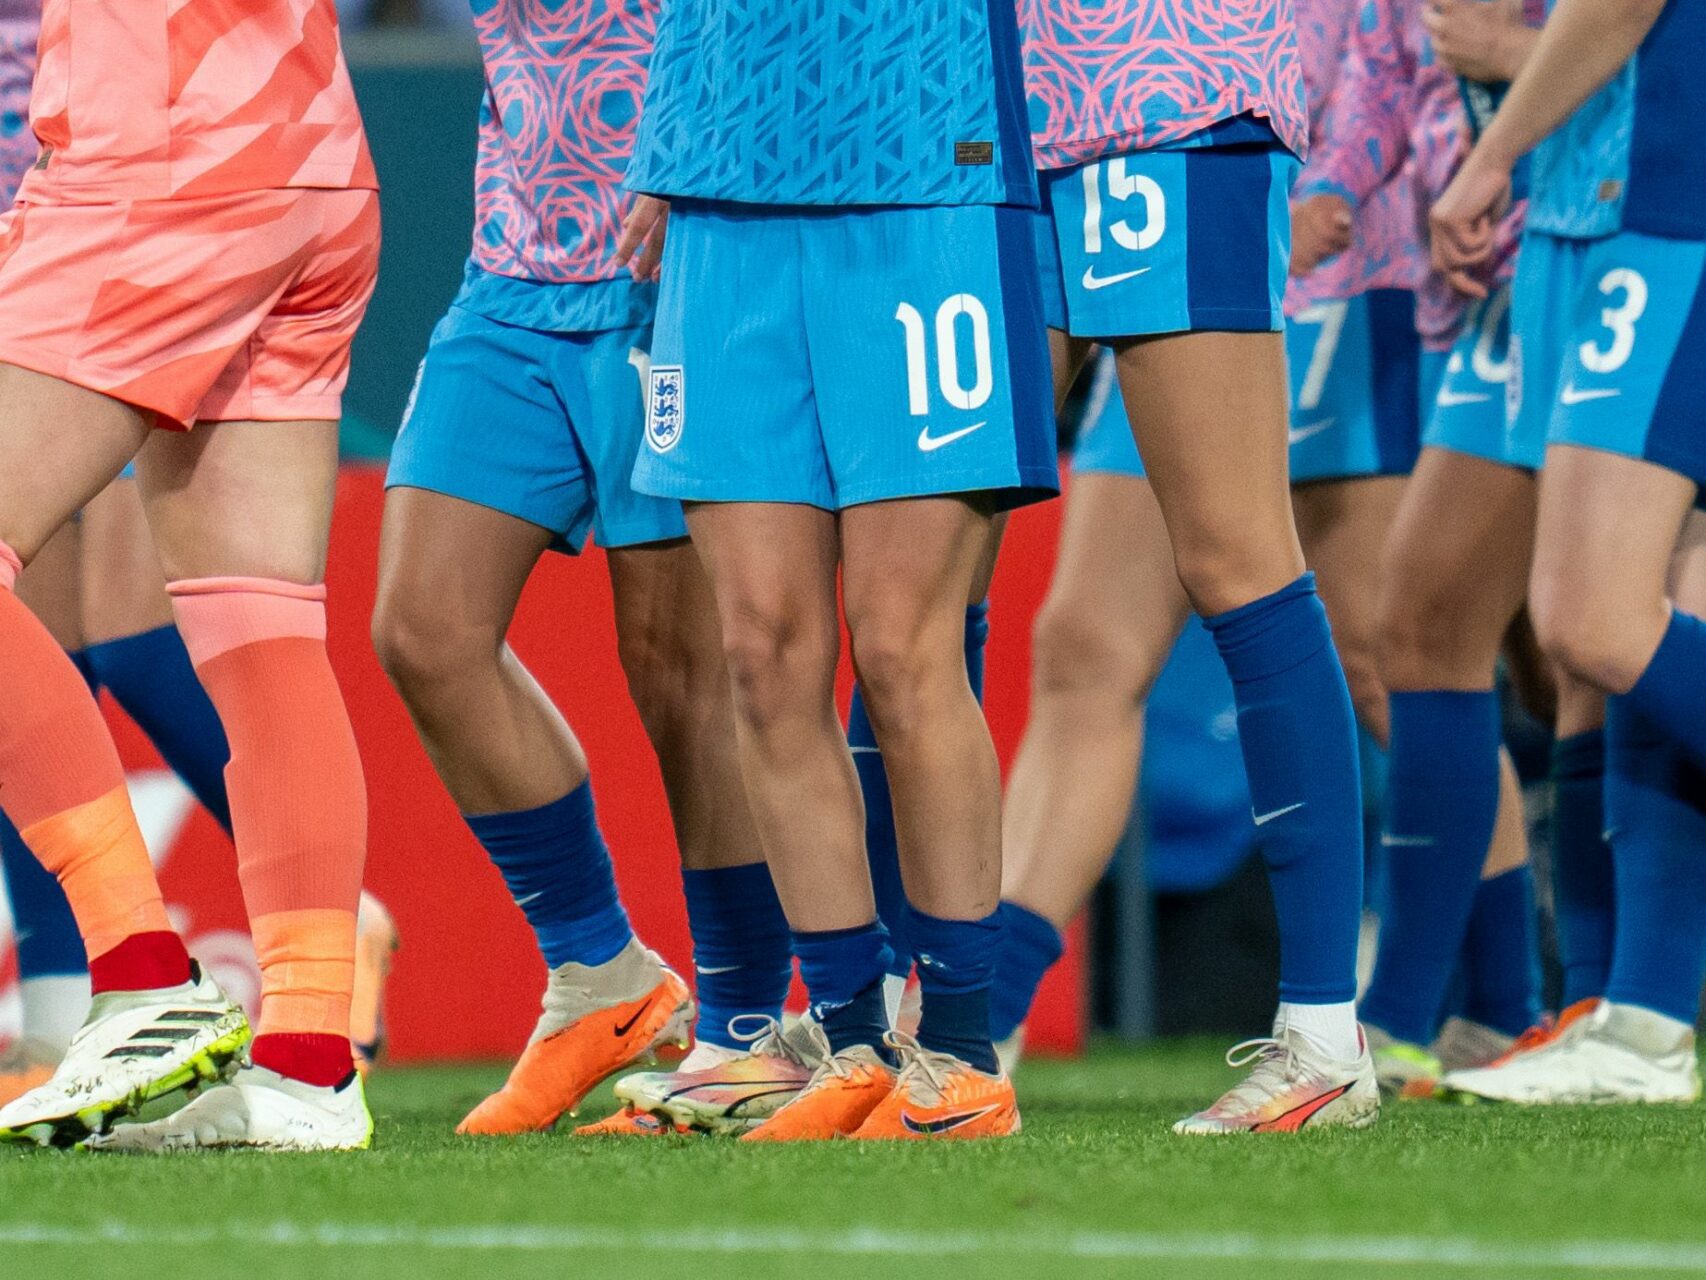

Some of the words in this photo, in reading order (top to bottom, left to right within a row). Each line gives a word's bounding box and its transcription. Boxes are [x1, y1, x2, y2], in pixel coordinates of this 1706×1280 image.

[1082, 156, 1166, 253] 15
[895, 293, 993, 416] 10
[1579, 267, 1648, 374] 3
